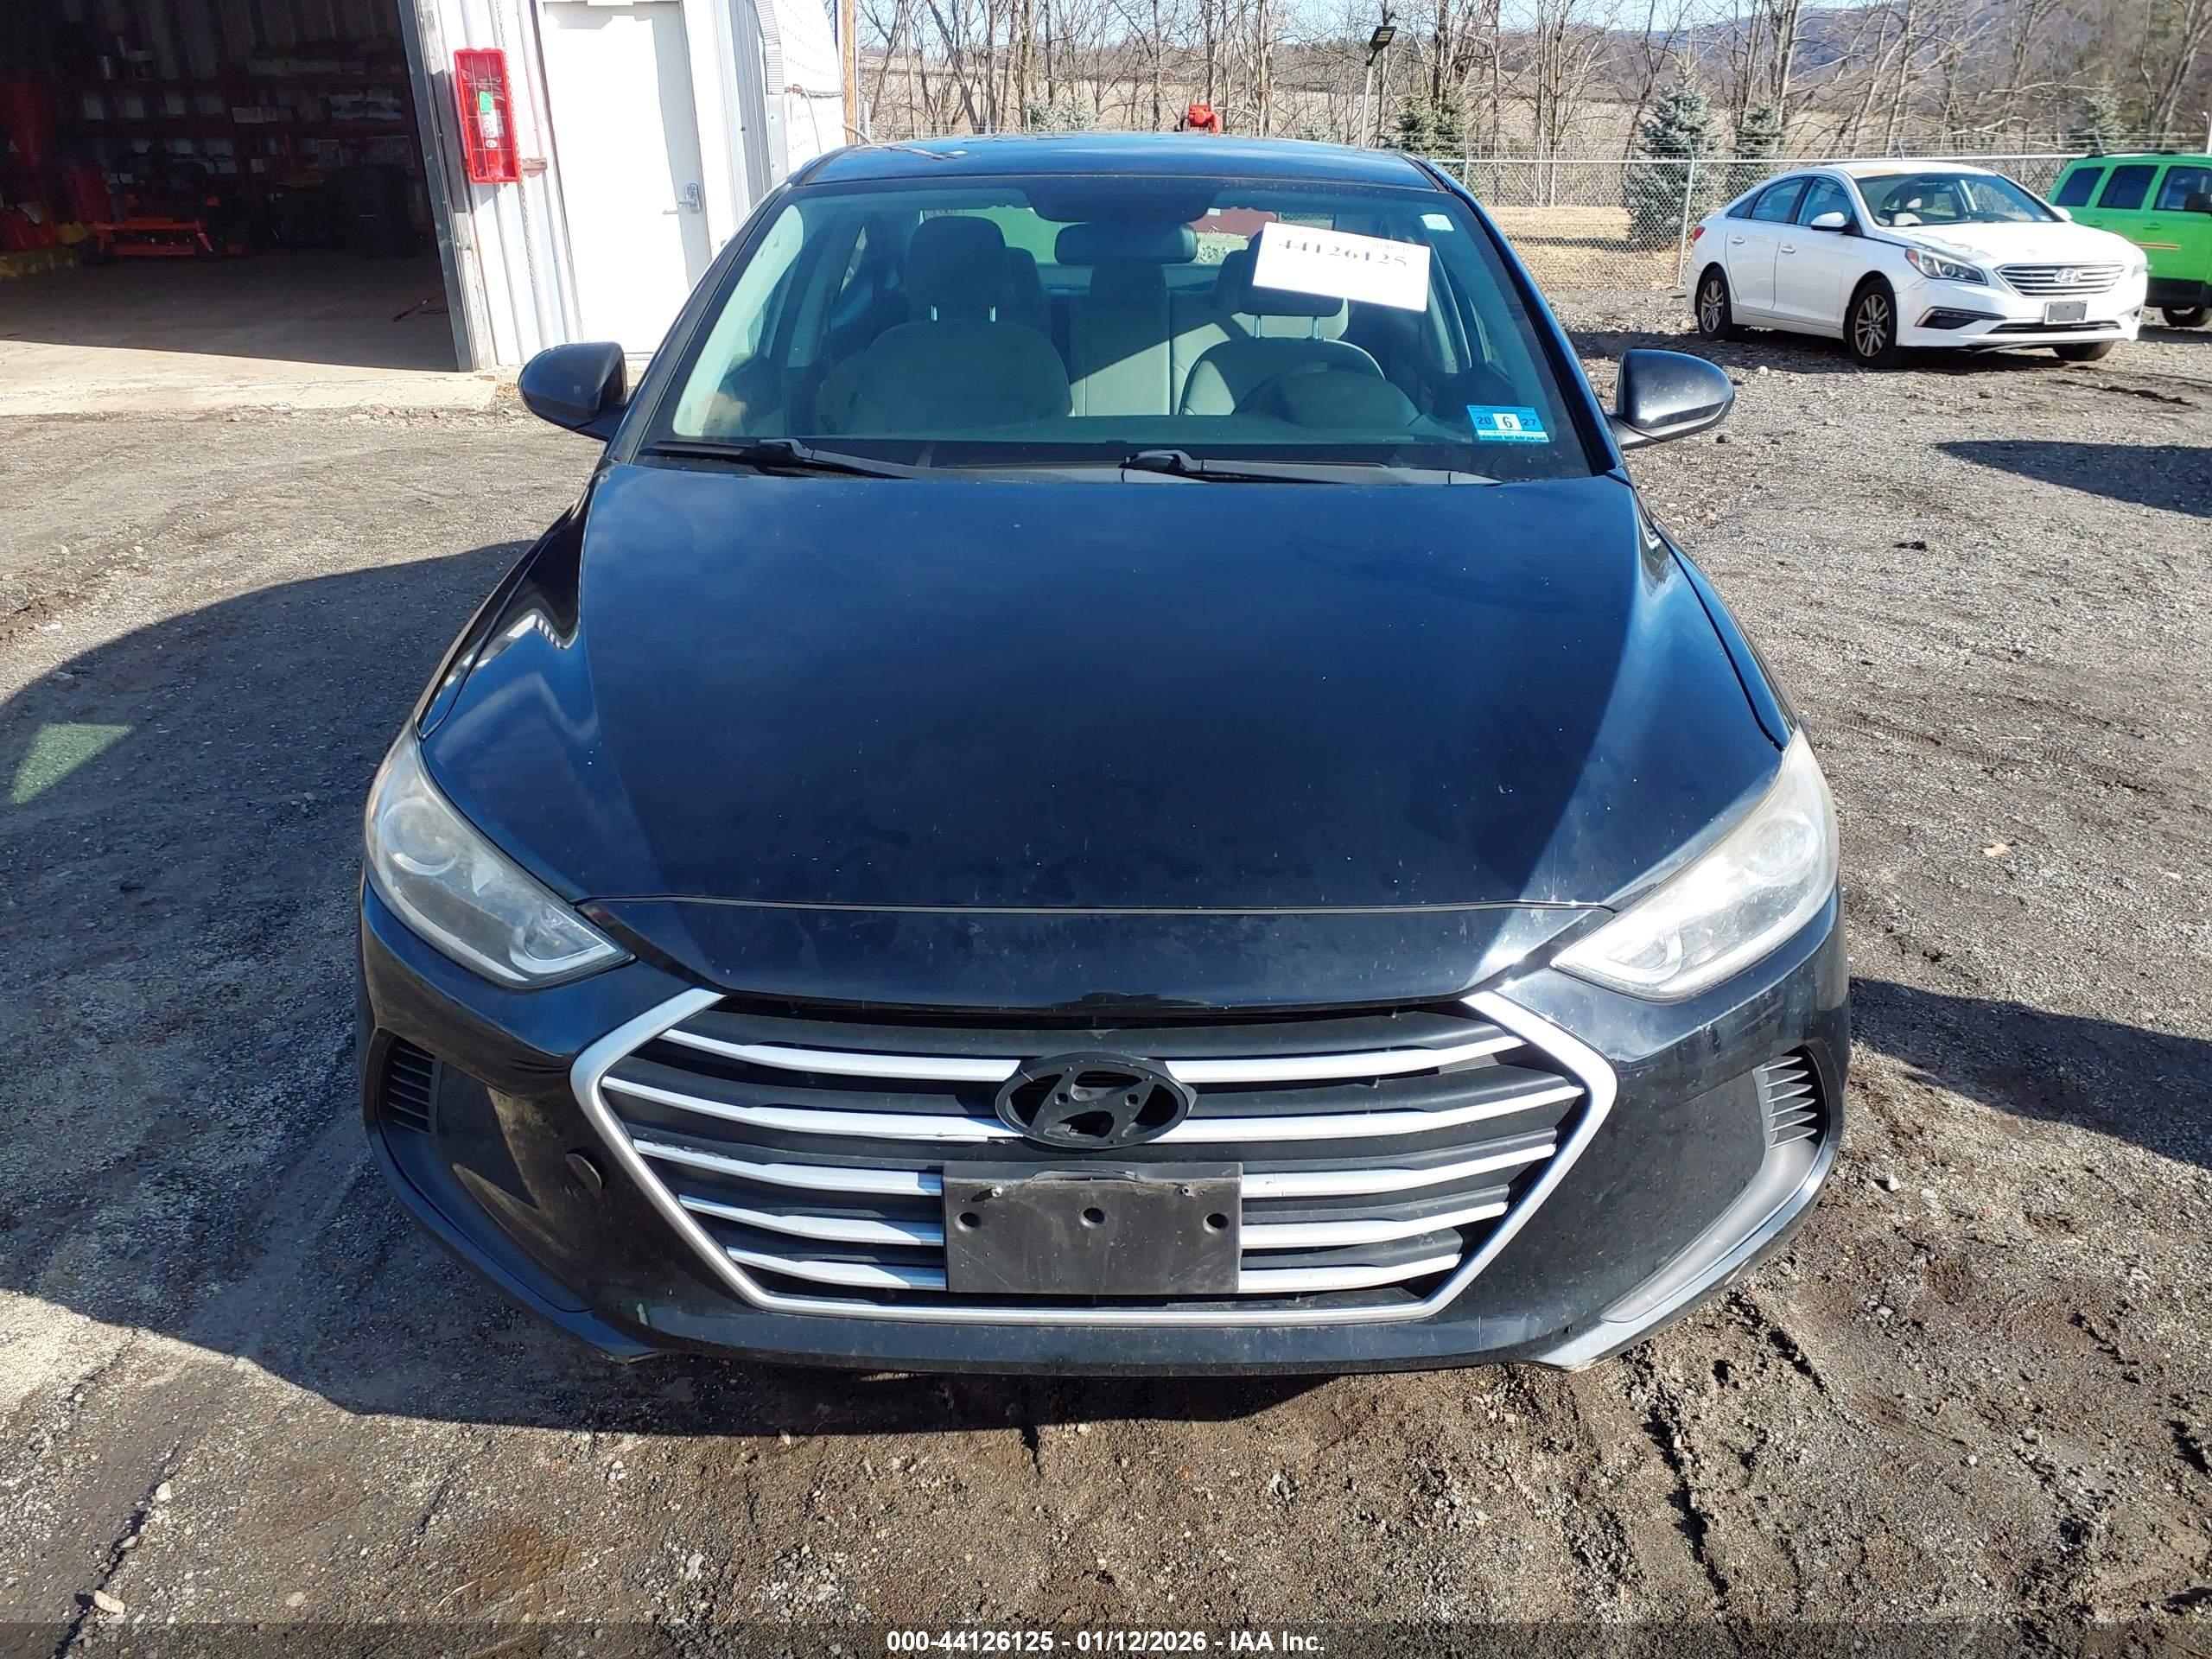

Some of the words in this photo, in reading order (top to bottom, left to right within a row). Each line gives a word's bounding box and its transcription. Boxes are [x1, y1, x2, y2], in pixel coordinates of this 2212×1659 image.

[1477, 416, 1491, 425] 20
[1503, 416, 1513, 429] 6
[1522, 418, 1536, 427] 27
